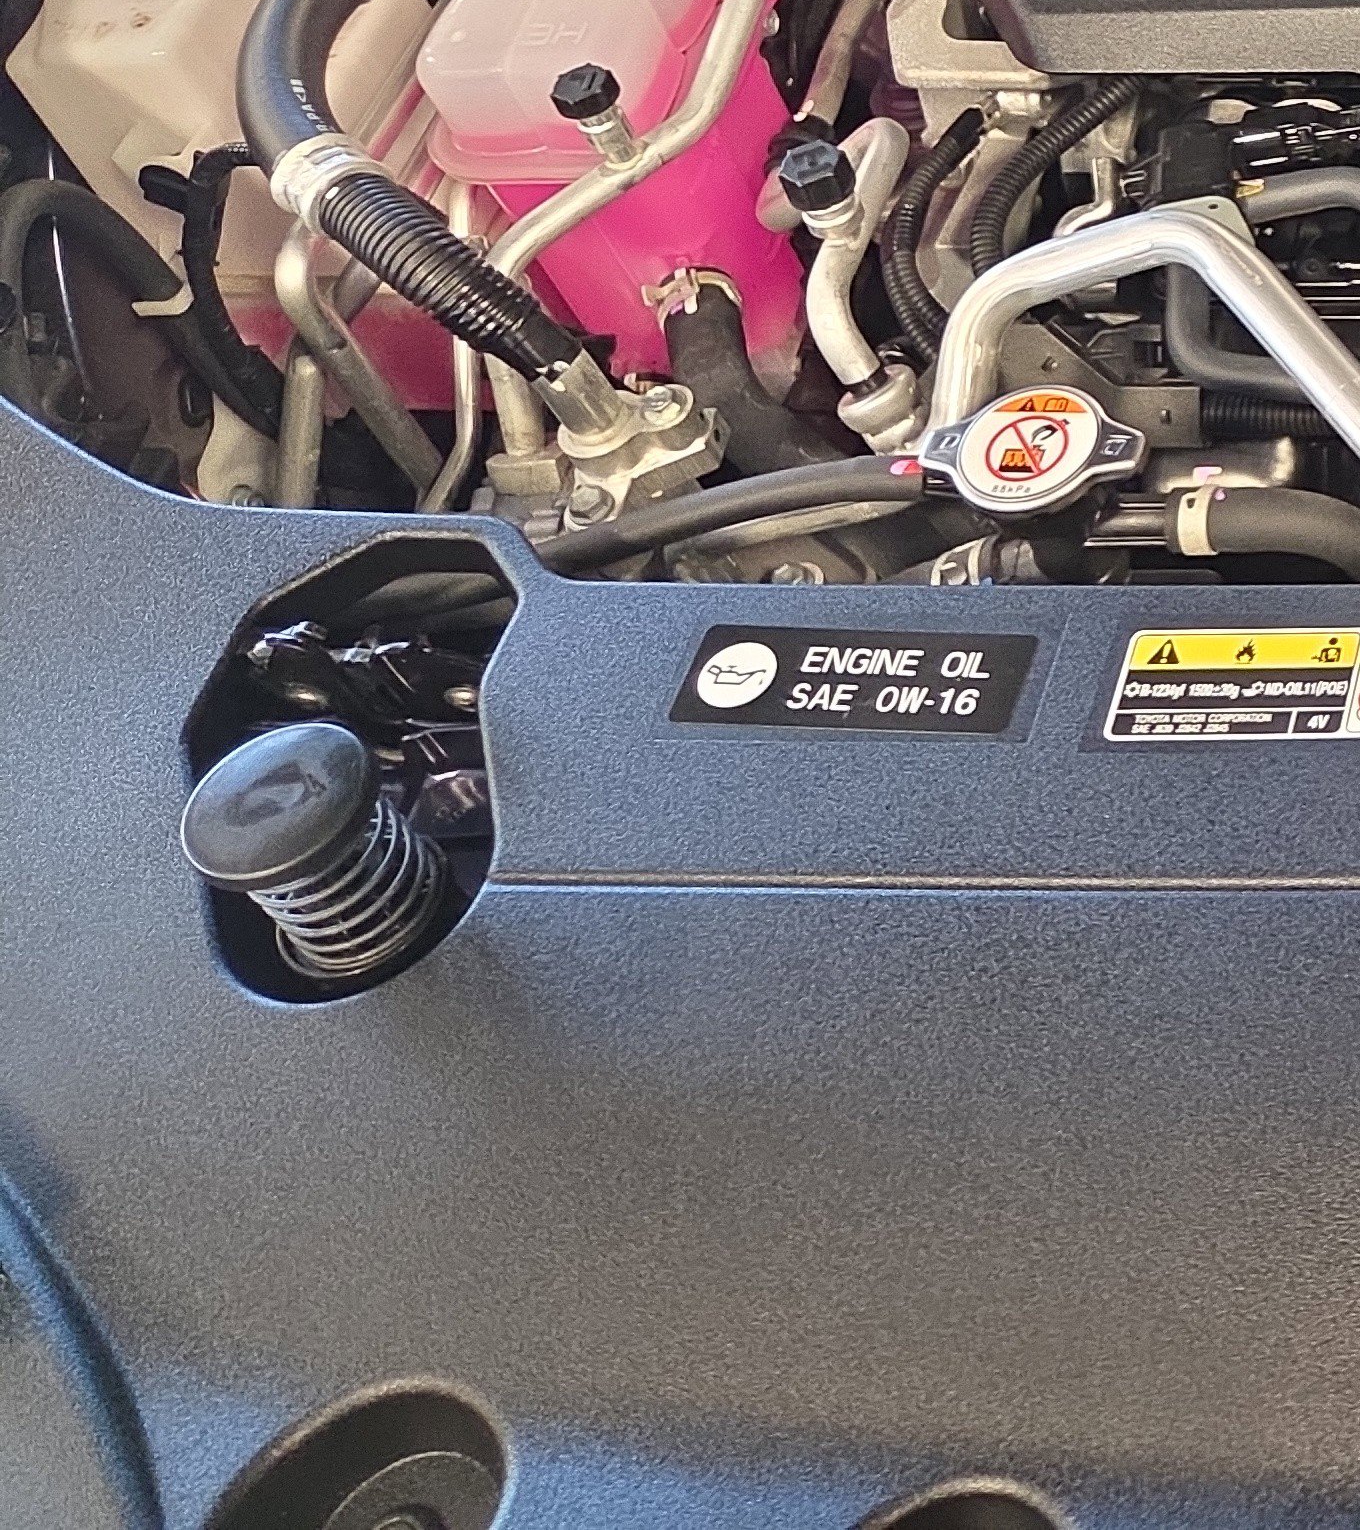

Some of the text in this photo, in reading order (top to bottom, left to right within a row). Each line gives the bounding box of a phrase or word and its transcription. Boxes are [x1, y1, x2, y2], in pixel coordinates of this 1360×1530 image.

[799, 646, 991, 680] ENGINE OIL
[786, 683, 981, 716] SAE 0W-16
[1135, 712, 1273, 723] TOYOTA MOTOR CORPORATION
[1307, 713, 1330, 729] 4V
